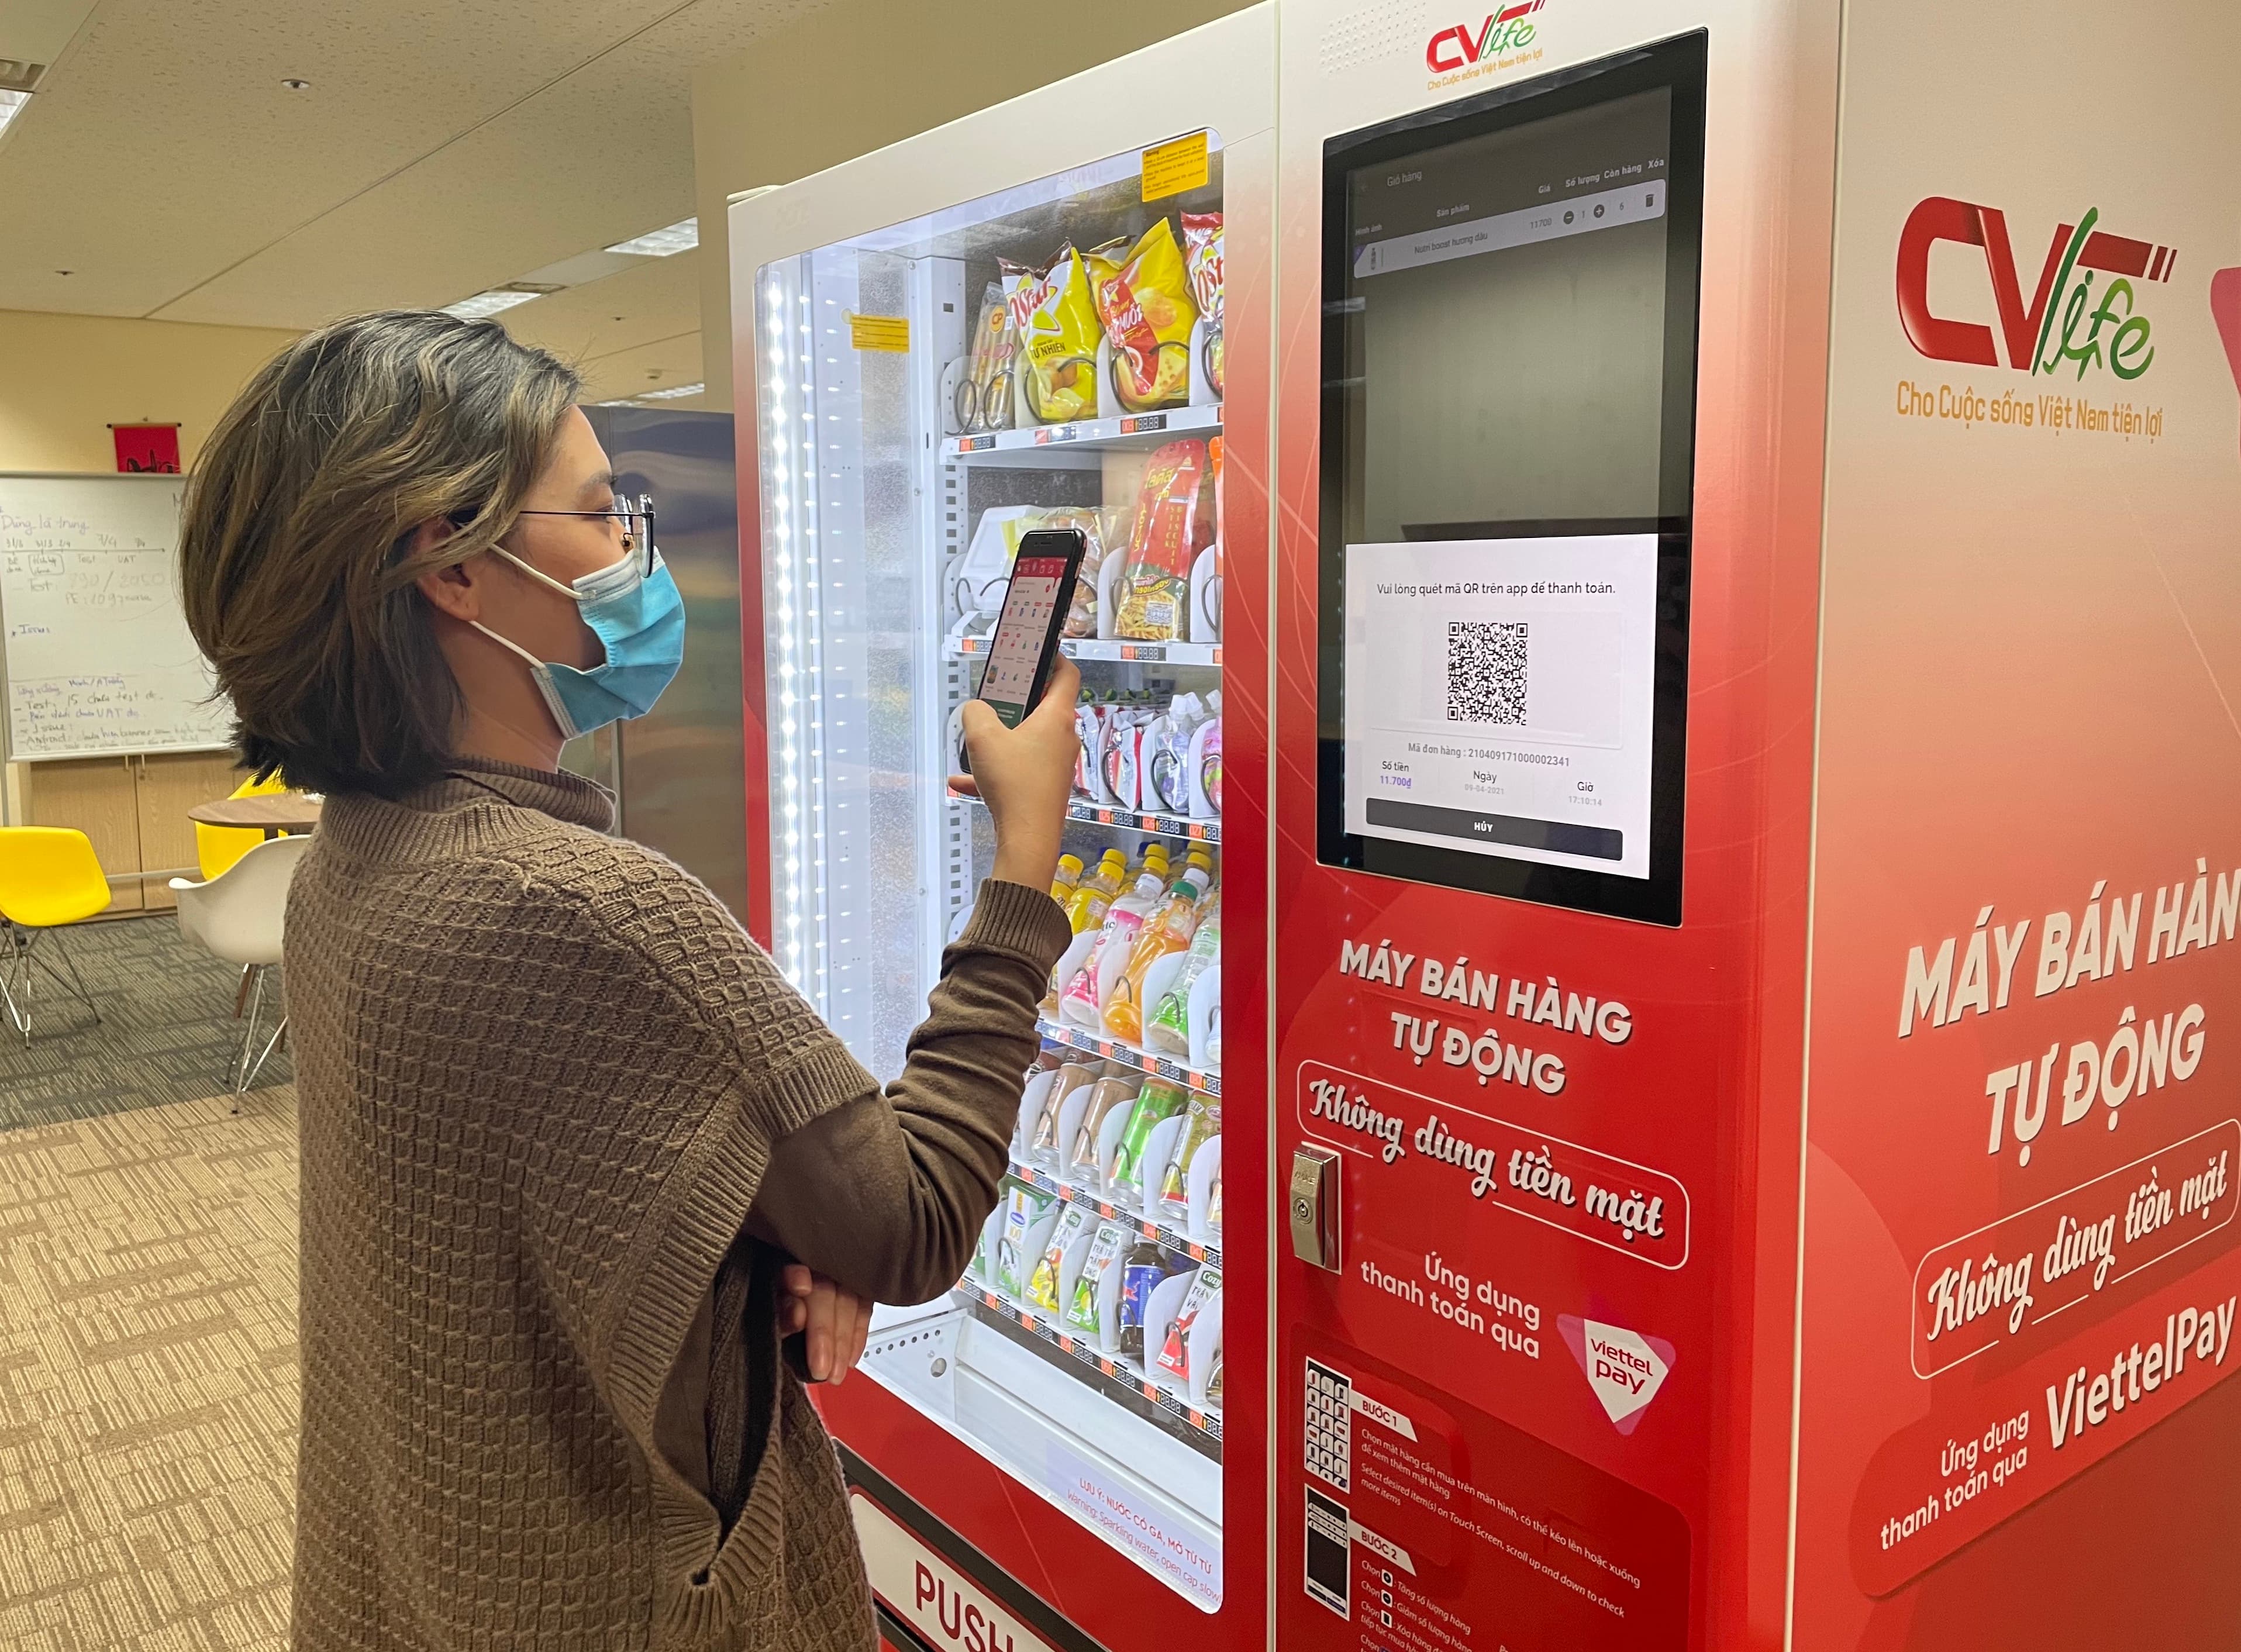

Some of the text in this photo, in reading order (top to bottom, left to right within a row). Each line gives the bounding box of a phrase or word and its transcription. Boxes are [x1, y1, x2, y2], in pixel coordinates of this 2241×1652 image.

[1428, 80, 1441, 91] Cho
[1442, 74, 1460, 86] Cuộc
[1461, 68, 1480, 81] sống
[1481, 63, 1496, 75] Việt
[1498, 58, 1515, 69] Nam
[1516, 53, 1531, 65] tiện
[1402, 171, 1422, 183] hàng
[1538, 157, 1664, 194] Giá Số lượng Còn hàng Xóa
[1619, 202, 1624, 211] 6
[1432, 239, 1450, 250] boost
[1897, 381, 2163, 444] Cho Cuộc sống Việt Nam tiện lợi
[1377, 581, 1616, 597] Vui lòng quét mã QR trên app để thanh toán.
[1382, 761, 1409, 772] Số tiền
[1408, 742, 1421, 753] Mã
[1422, 744, 1438, 754] đơn
[1440, 745, 1461, 759] hàng
[1464, 784, 1504, 795] 09-04-2021
[1473, 771, 1497, 784] Ngày
[1577, 781, 1594, 792] Giờ
[1568, 796, 1602, 806] 17:10:14
[1474, 820, 1493, 833] HỦY
[1898, 904, 2031, 1039] MÁY
[2035, 880, 2143, 998] BÁN
[1339, 939, 1633, 1044] MÁY BÁN HÀNG
[1391, 1012, 1567, 1095] TỰ ĐỘNG
[1985, 1003, 2205, 1167] TỰ ĐỘNG
[1308, 1078, 1666, 1241] Không dùng tiền mặt
[1927, 1150, 2228, 1342] Không dùng tiền mặt
[1360, 1260, 1540, 1360] thanh toán qua
[1425, 1251, 1542, 1331] Ứng dụng
[1591, 1337, 1654, 1377] viettel
[1596, 1359, 1646, 1395] pay
[2046, 1295, 2237, 1450] ViettelPay
[1362, 1399, 1397, 1427] BƯỚC 1
[1941, 1410, 2029, 1478] Ứng dụng
[1361, 1478, 1401, 1506] more items
[1373, 1450, 1389, 1464] xem
[1391, 1458, 1411, 1476] thêm
[1412, 1471, 1428, 1486] mặt
[1430, 1478, 1450, 1500] hàng
[1361, 1429, 1382, 1446] Chọn
[1383, 1443, 1398, 1456] mặt
[1399, 1447, 1420, 1468] hàng
[1421, 1462, 1436, 1476] cần
[1437, 1471, 1456, 1486] mua
[1457, 1479, 1475, 1495] trên
[1477, 1490, 1496, 1507] màn
[1521, 1515, 1531, 1526] có
[1550, 1529, 1566, 1546] kéo
[1568, 1539, 1583, 1555] lên
[1584, 1547, 1608, 1568] hoặc
[1609, 1563, 1640, 1589] xuống
[1880, 1447, 2028, 1550] thanh toán qua
[1080, 1478, 1095, 1495] LƯU
[1106, 1496, 1132, 1520] NƯỚC
[1133, 1514, 1147, 1530] CÓ
[1167, 1537, 1183, 1555] MỞ
[1185, 1548, 1198, 1565] TỪ
[1199, 1558, 1212, 1574] TỪ
[1361, 1463, 1382, 1482] Select
[1383, 1475, 1410, 1496] desired
[1411, 1491, 1437, 1512] item(s)
[1438, 1507, 1448, 1519] on
[1449, 1512, 1475, 1532] Touch
[1506, 1544, 1528, 1562] scroll
[1529, 1557, 1541, 1570] up
[1542, 1565, 1560, 1580] and
[1560, 1575, 1585, 1595] down
[1587, 1589, 1597, 1602] to
[1598, 1597, 1625, 1619] check
[1361, 1530, 1397, 1560] BƯỚC 2
[1099, 1511, 1133, 1544] Sparkling
[1135, 1538, 1160, 1561] water,
[1161, 1556, 1182, 1577] open
[1183, 1572, 1198, 1587] cap
[1361, 1560, 1381, 1578] Chọn
[1426, 1598, 1449, 1622] lượng
[1450, 1613, 1471, 1636] hàng
[1361, 1601, 1380, 1619] Chọn
[1361, 1580, 1380, 1598] Chọn
[1428, 1621, 1451, 1645] lượng
[1361, 1614, 1374, 1630] tiếp
[1388, 1632, 1405, 1648] mua
